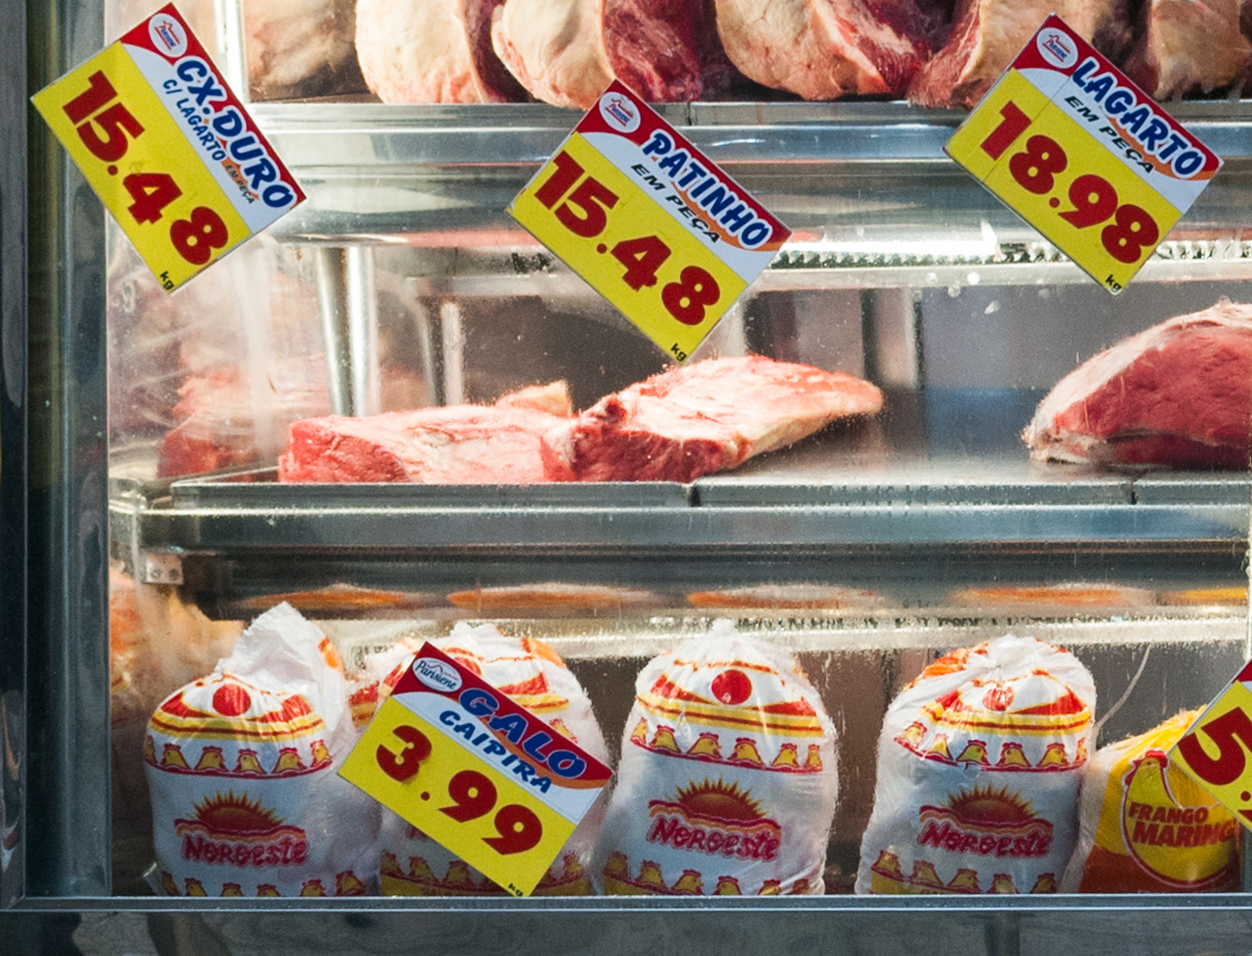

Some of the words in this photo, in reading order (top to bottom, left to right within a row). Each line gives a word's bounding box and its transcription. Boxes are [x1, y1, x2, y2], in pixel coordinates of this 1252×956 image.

[176, 97, 227, 161] LAGARTO
[1064, 96, 1099, 123] EM
[1099, 126, 1154, 174] PEÇA
[1072, 60, 1203, 175] LAGARTO
[62, 70, 228, 265] 15.48
[631, 164, 666, 191] EM
[666, 195, 721, 243] PEÇA
[642, 133, 769, 246] PATINHO
[980, 100, 1159, 264] 18.98
[534, 150, 721, 326] 15.48
[159, 271, 175, 291] kg
[1105, 275, 1122, 292] kg
[671, 343, 688, 362] kg
[439, 710, 552, 793] CAIPIRA
[459, 688, 586, 778] GALO
[376, 725, 543, 855] 3.99
[1129, 802, 1208, 824] FRANGO
[1132, 820, 1236, 847] MARING
